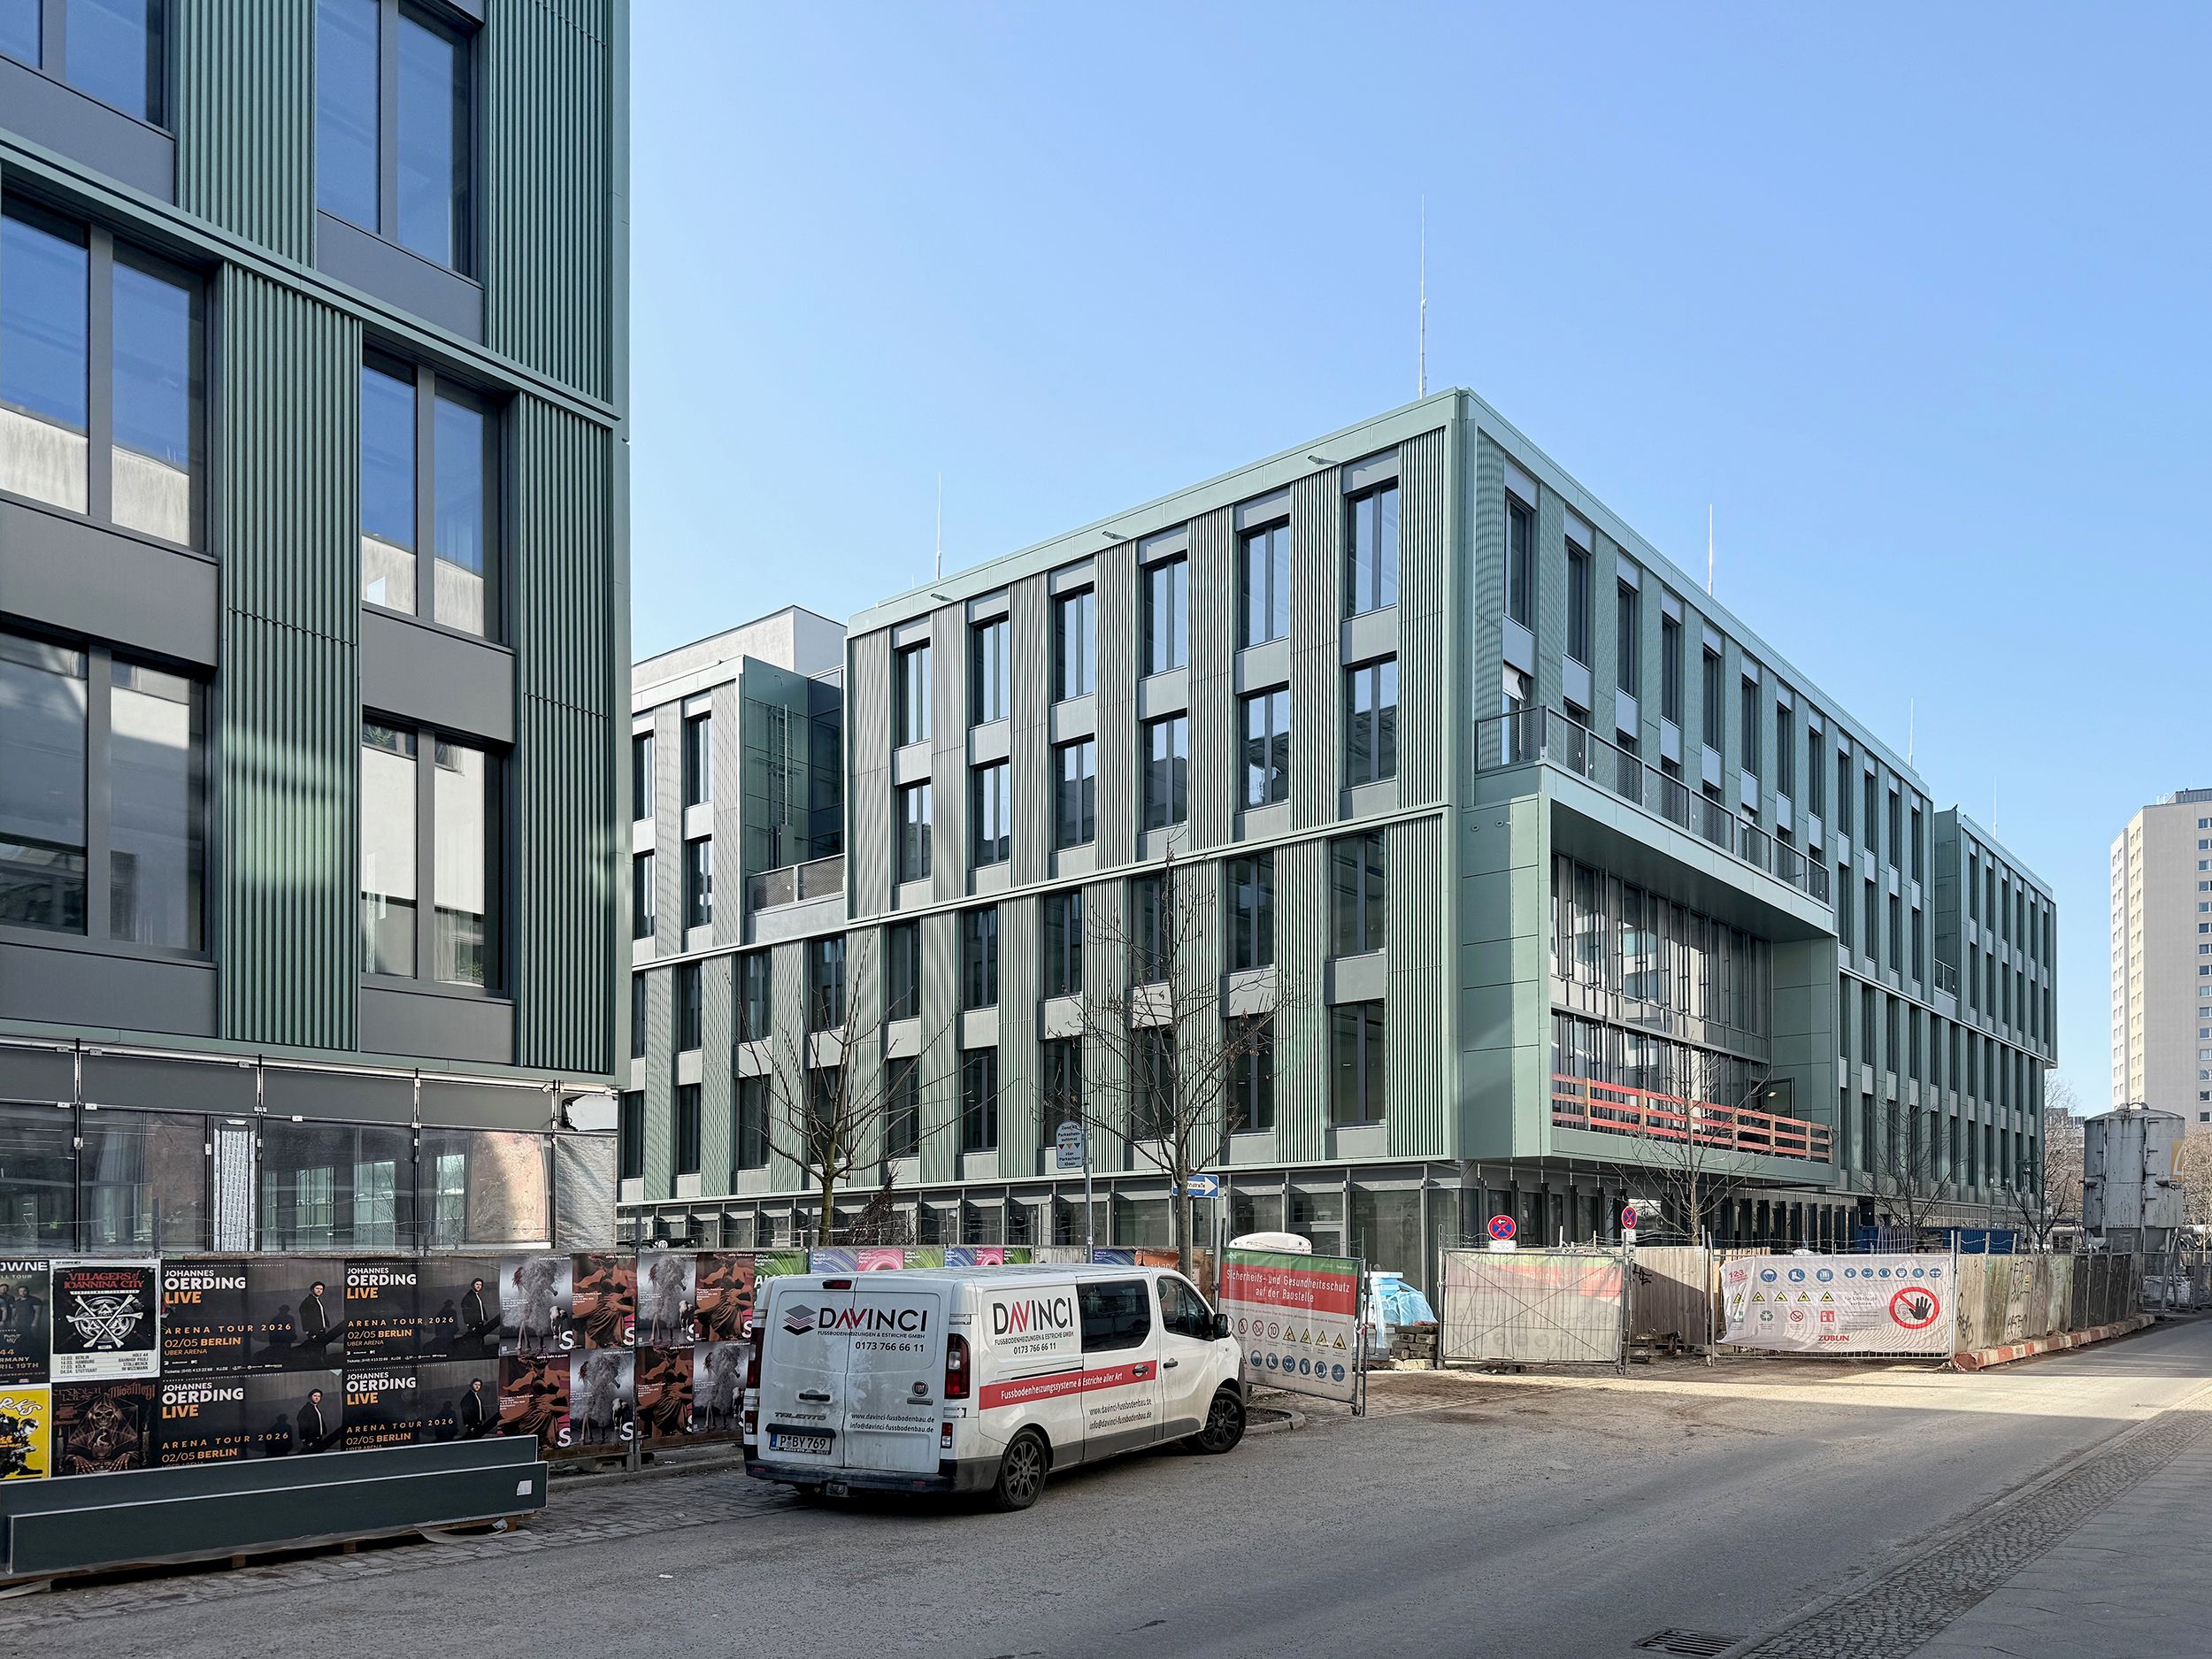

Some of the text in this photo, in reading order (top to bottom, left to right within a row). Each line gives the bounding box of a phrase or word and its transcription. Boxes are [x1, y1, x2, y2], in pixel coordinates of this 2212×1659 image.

[165, 1277, 246, 1290] OERDING
[347, 1274, 417, 1286] OERDING
[1226, 1269, 1350, 1293] Sicherheits- und Gesundheitsschutz
[165, 1291, 202, 1304] LIVE
[347, 1287, 378, 1299] LIVE
[1255, 1287, 1314, 1303] auf der Baustelle
[818, 1308, 928, 1332] DAVINCI
[993, 1297, 1073, 1335] DAVINCI
[165, 1326, 211, 1335] ARENA
[219, 1325, 254, 1333] TOUR
[347, 1329, 412, 1339] 02/05 BERLIN
[1270, 1326, 1276, 1336] 10
[165, 1337, 242, 1348] 02/05 BERLIN
[995, 1335, 1041, 1345] FUSSBODENHEIZUNGEN
[856, 1342, 877, 1350] 0173
[899, 1343, 910, 1352] 66
[1014, 1346, 1028, 1354] 0173
[347, 1372, 389, 1380] JOHANNES
[162, 1382, 212, 1392] JOHANNES
[346, 1377, 416, 1392] OERDING
[1001, 1380, 1077, 1400] Fussbodenheizungssysteme
[1083, 1375, 1102, 1386] Estriche
[1103, 1374, 1114, 1383] aller
[1114, 1372, 1123, 1381] Art
[162, 1387, 244, 1405] OERDING
[347, 1392, 378, 1406] LIVE
[162, 1404, 199, 1419] LIVE
[1090, 1398, 1152, 1416] www.davinci-fussbodenbau.de
[851, 1413, 935, 1423] www.davinci-fussbodenbau.de
[1089, 1412, 1152, 1430] info@davinci-fussbodenbau.de
[347, 1424, 385, 1433] ARENA
[392, 1421, 422, 1430] TOUR
[850, 1423, 934, 1433] info@davinci-fussbodenbau.de
[162, 1432, 288, 1449] ARENA TOUR 2026
[346, 1432, 411, 1445] 02/05 BERLIN
[780, 1436, 826, 1449] P BY 769
[162, 1448, 238, 1462] 02/05 BERLIN
